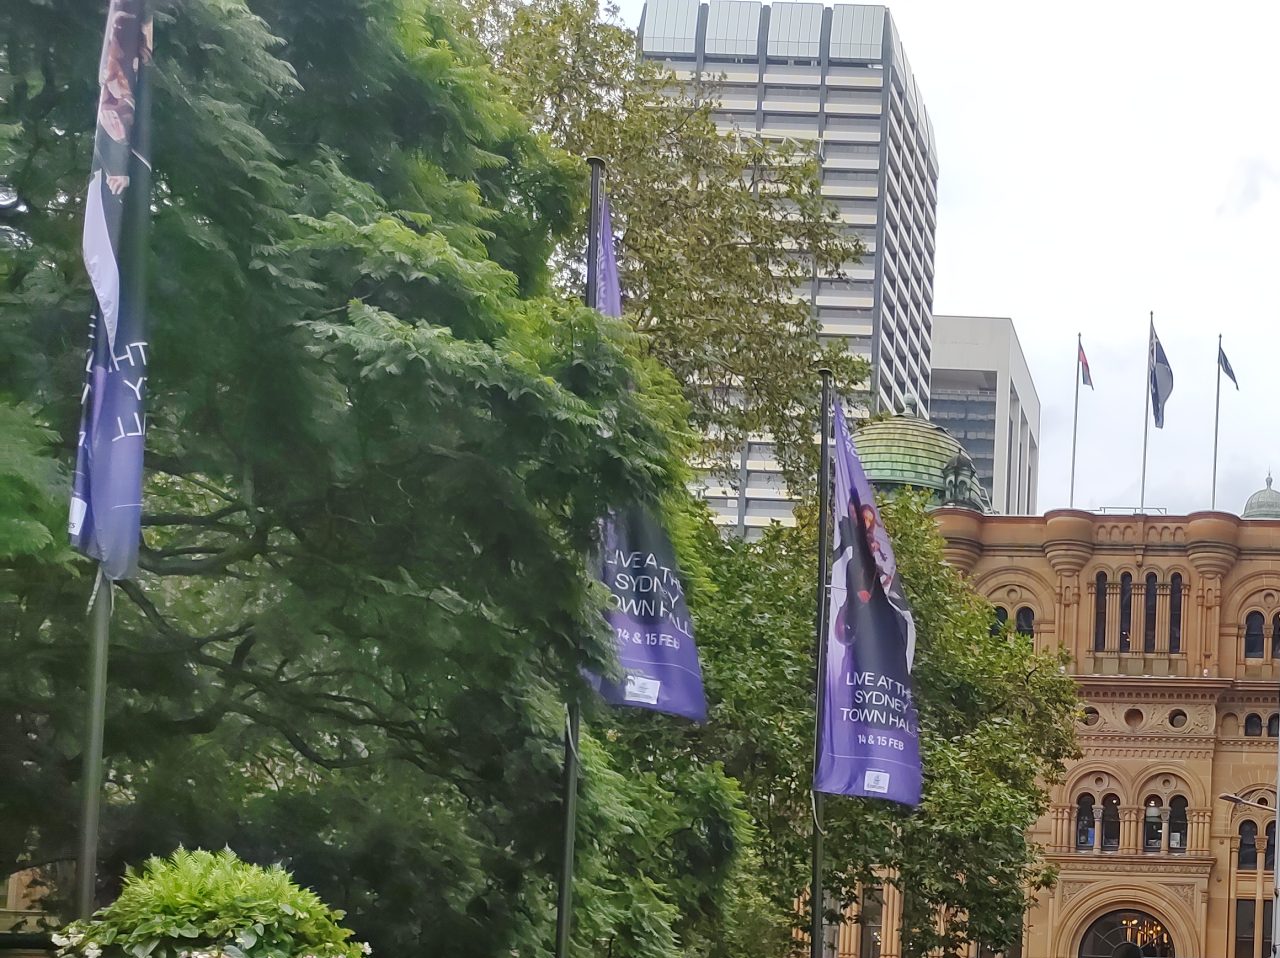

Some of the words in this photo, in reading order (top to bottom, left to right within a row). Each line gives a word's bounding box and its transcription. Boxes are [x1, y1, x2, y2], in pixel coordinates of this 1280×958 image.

[614, 573, 679, 609] SYDNY
[608, 593, 656, 617] OWN
[645, 632, 657, 646] 15
[846, 671, 875, 686] LIVE
[877, 675, 896, 691] AT
[855, 690, 911, 714] SYDNEY
[840, 707, 886, 724] TOWN
[868, 734, 875, 745] &
[877, 735, 887, 746] 15
[888, 737, 904, 751] FEB
